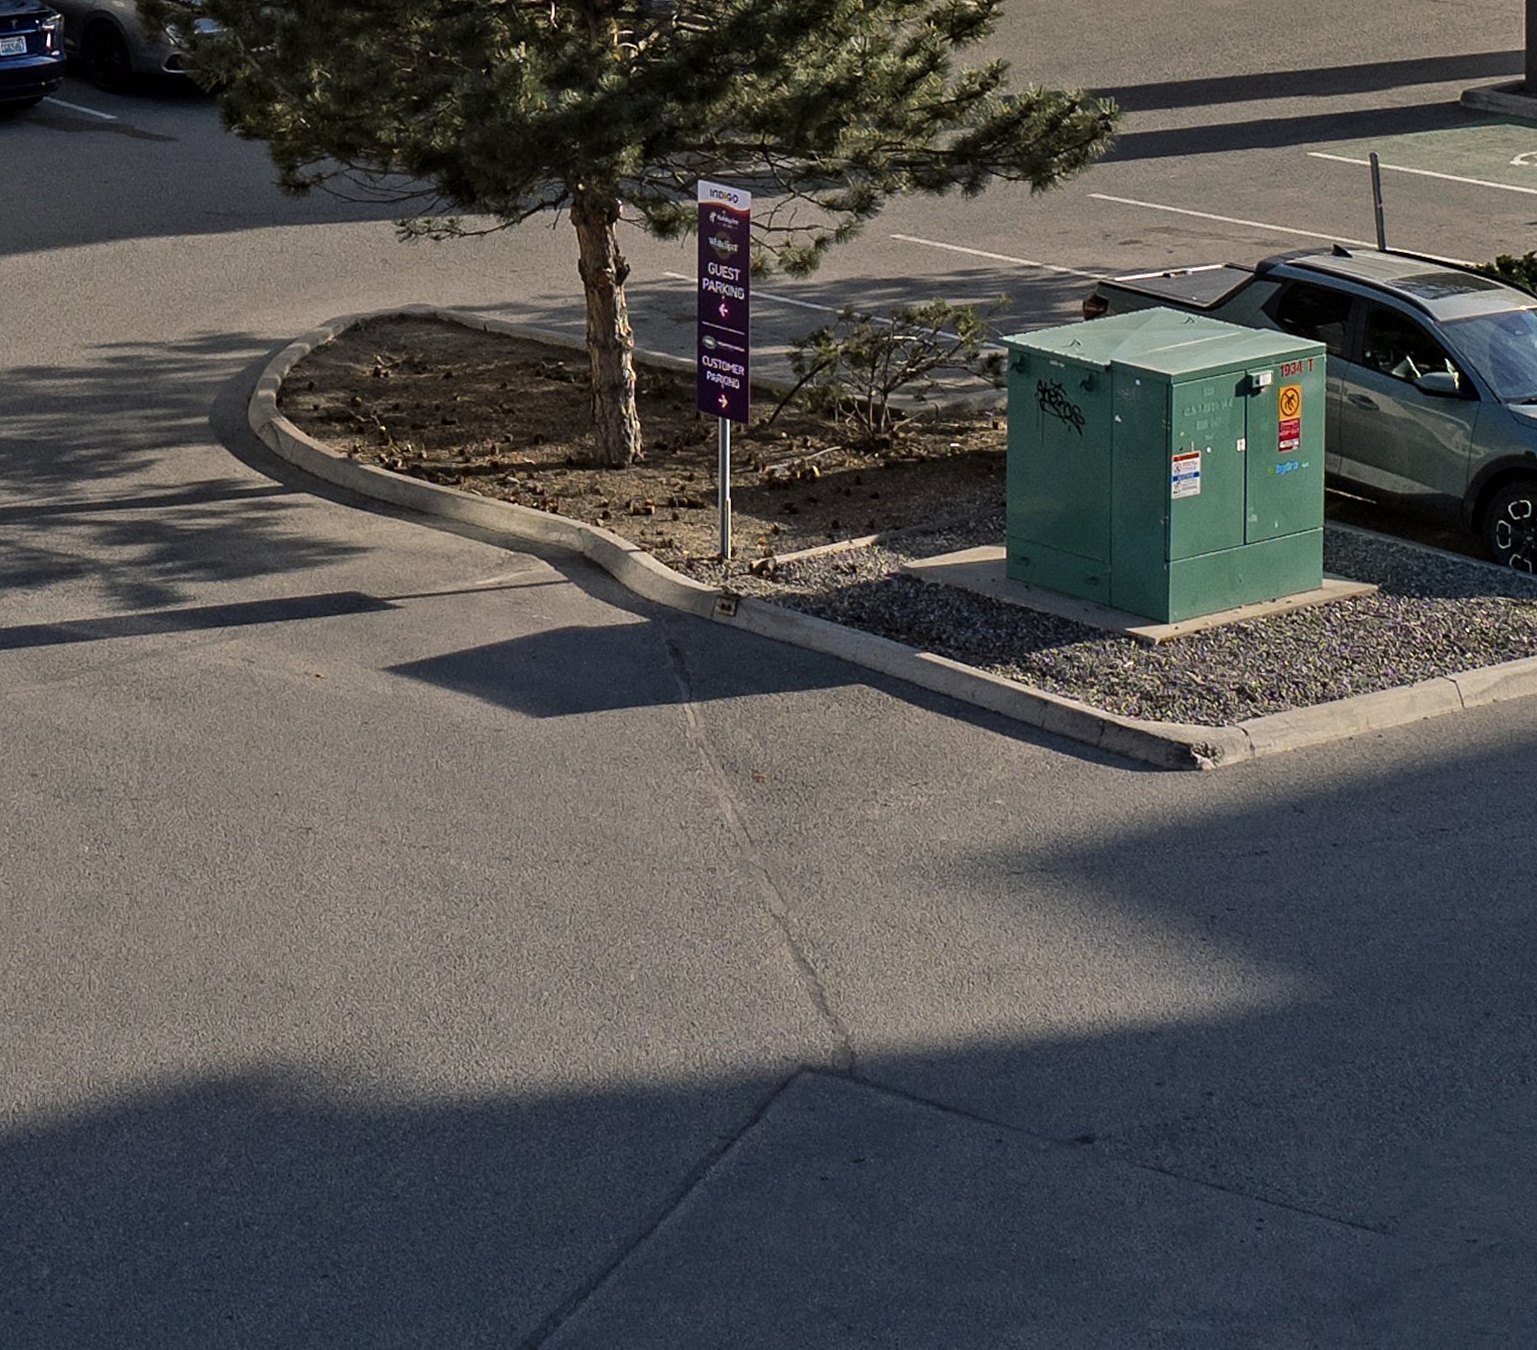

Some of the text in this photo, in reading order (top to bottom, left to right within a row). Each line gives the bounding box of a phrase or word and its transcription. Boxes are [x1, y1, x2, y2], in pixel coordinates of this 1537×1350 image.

[707, 262, 741, 282] GUEST
[702, 277, 745, 301] PARKING
[702, 355, 745, 376] CUSTOMER
[1279, 361, 1303, 377] 1934
